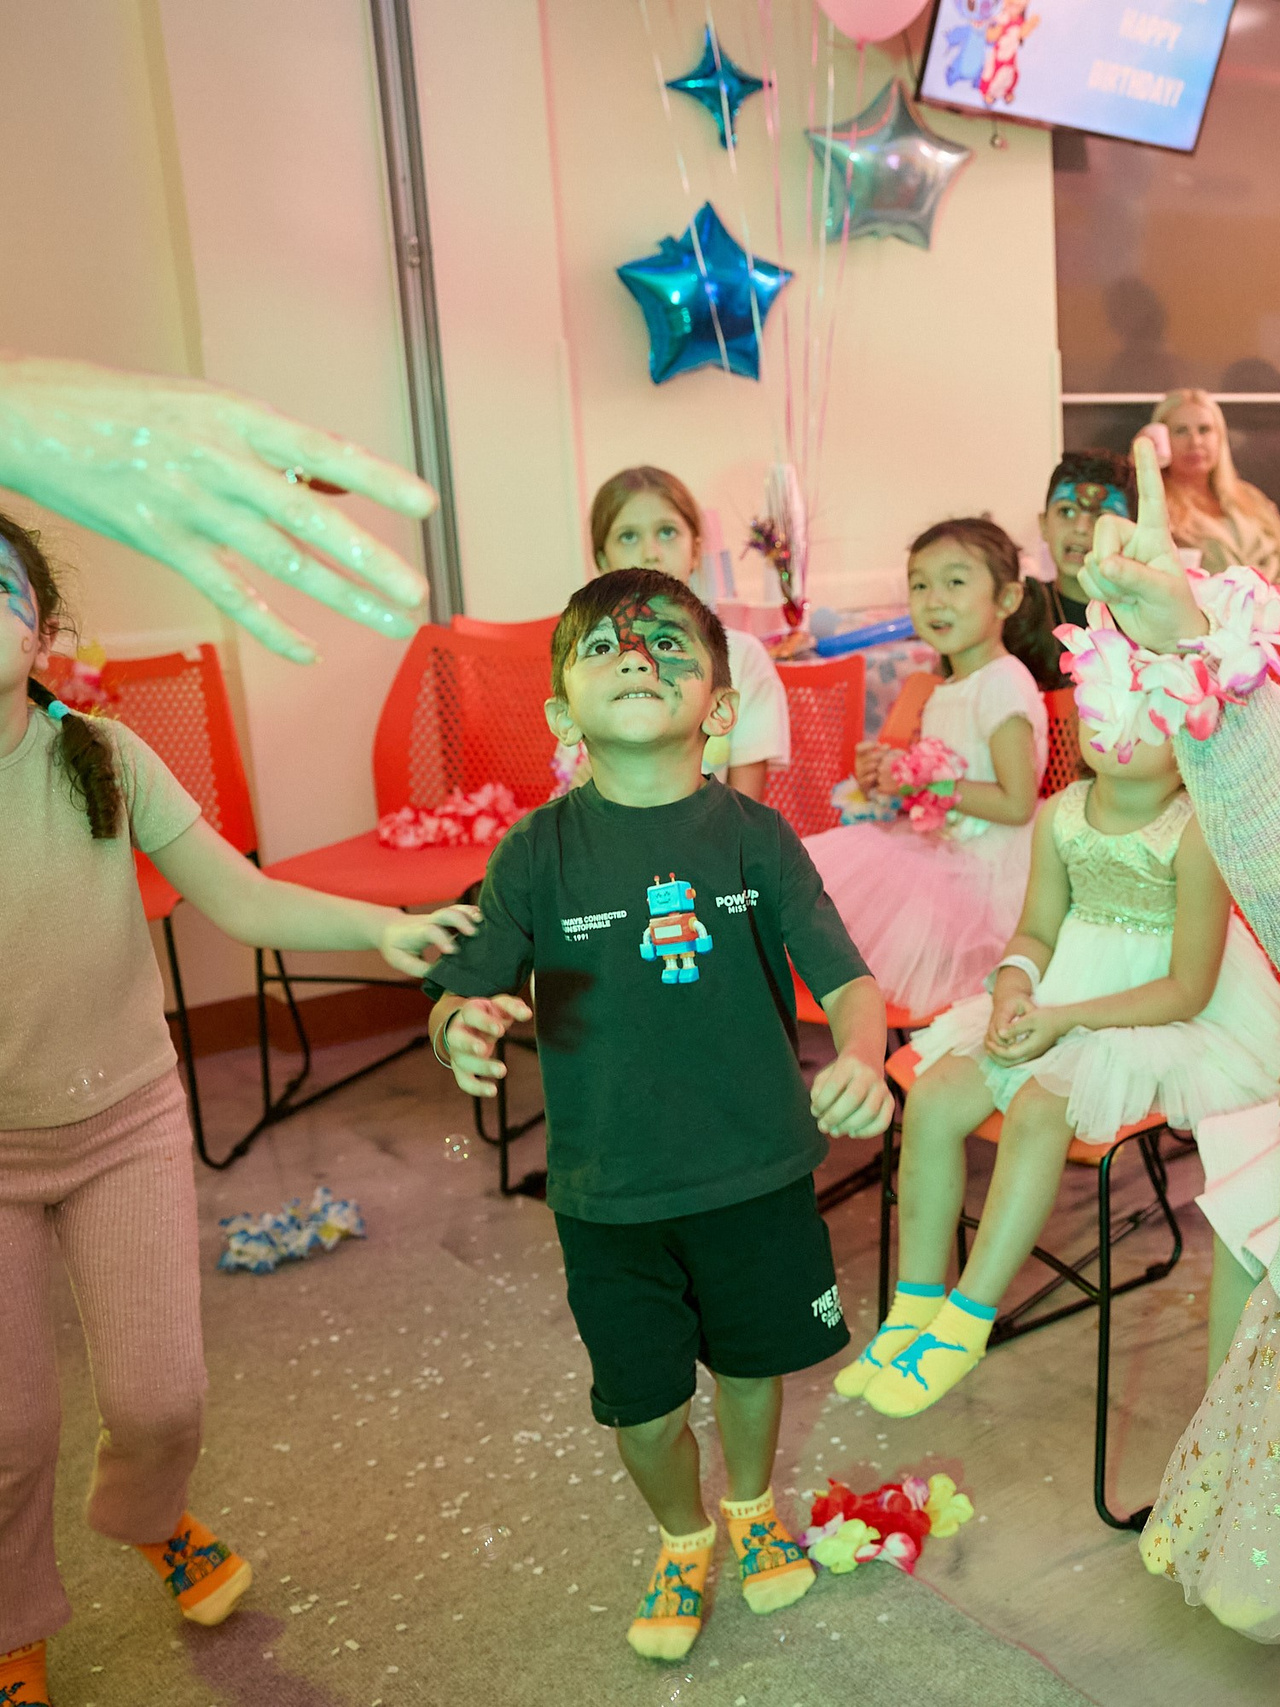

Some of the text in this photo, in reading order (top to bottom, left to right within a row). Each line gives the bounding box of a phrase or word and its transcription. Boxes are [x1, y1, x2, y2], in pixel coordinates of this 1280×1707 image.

[583, 909, 628, 924] CONNECTED
[573, 932, 589, 942] 1991
[811, 1289, 834, 1318] THE
